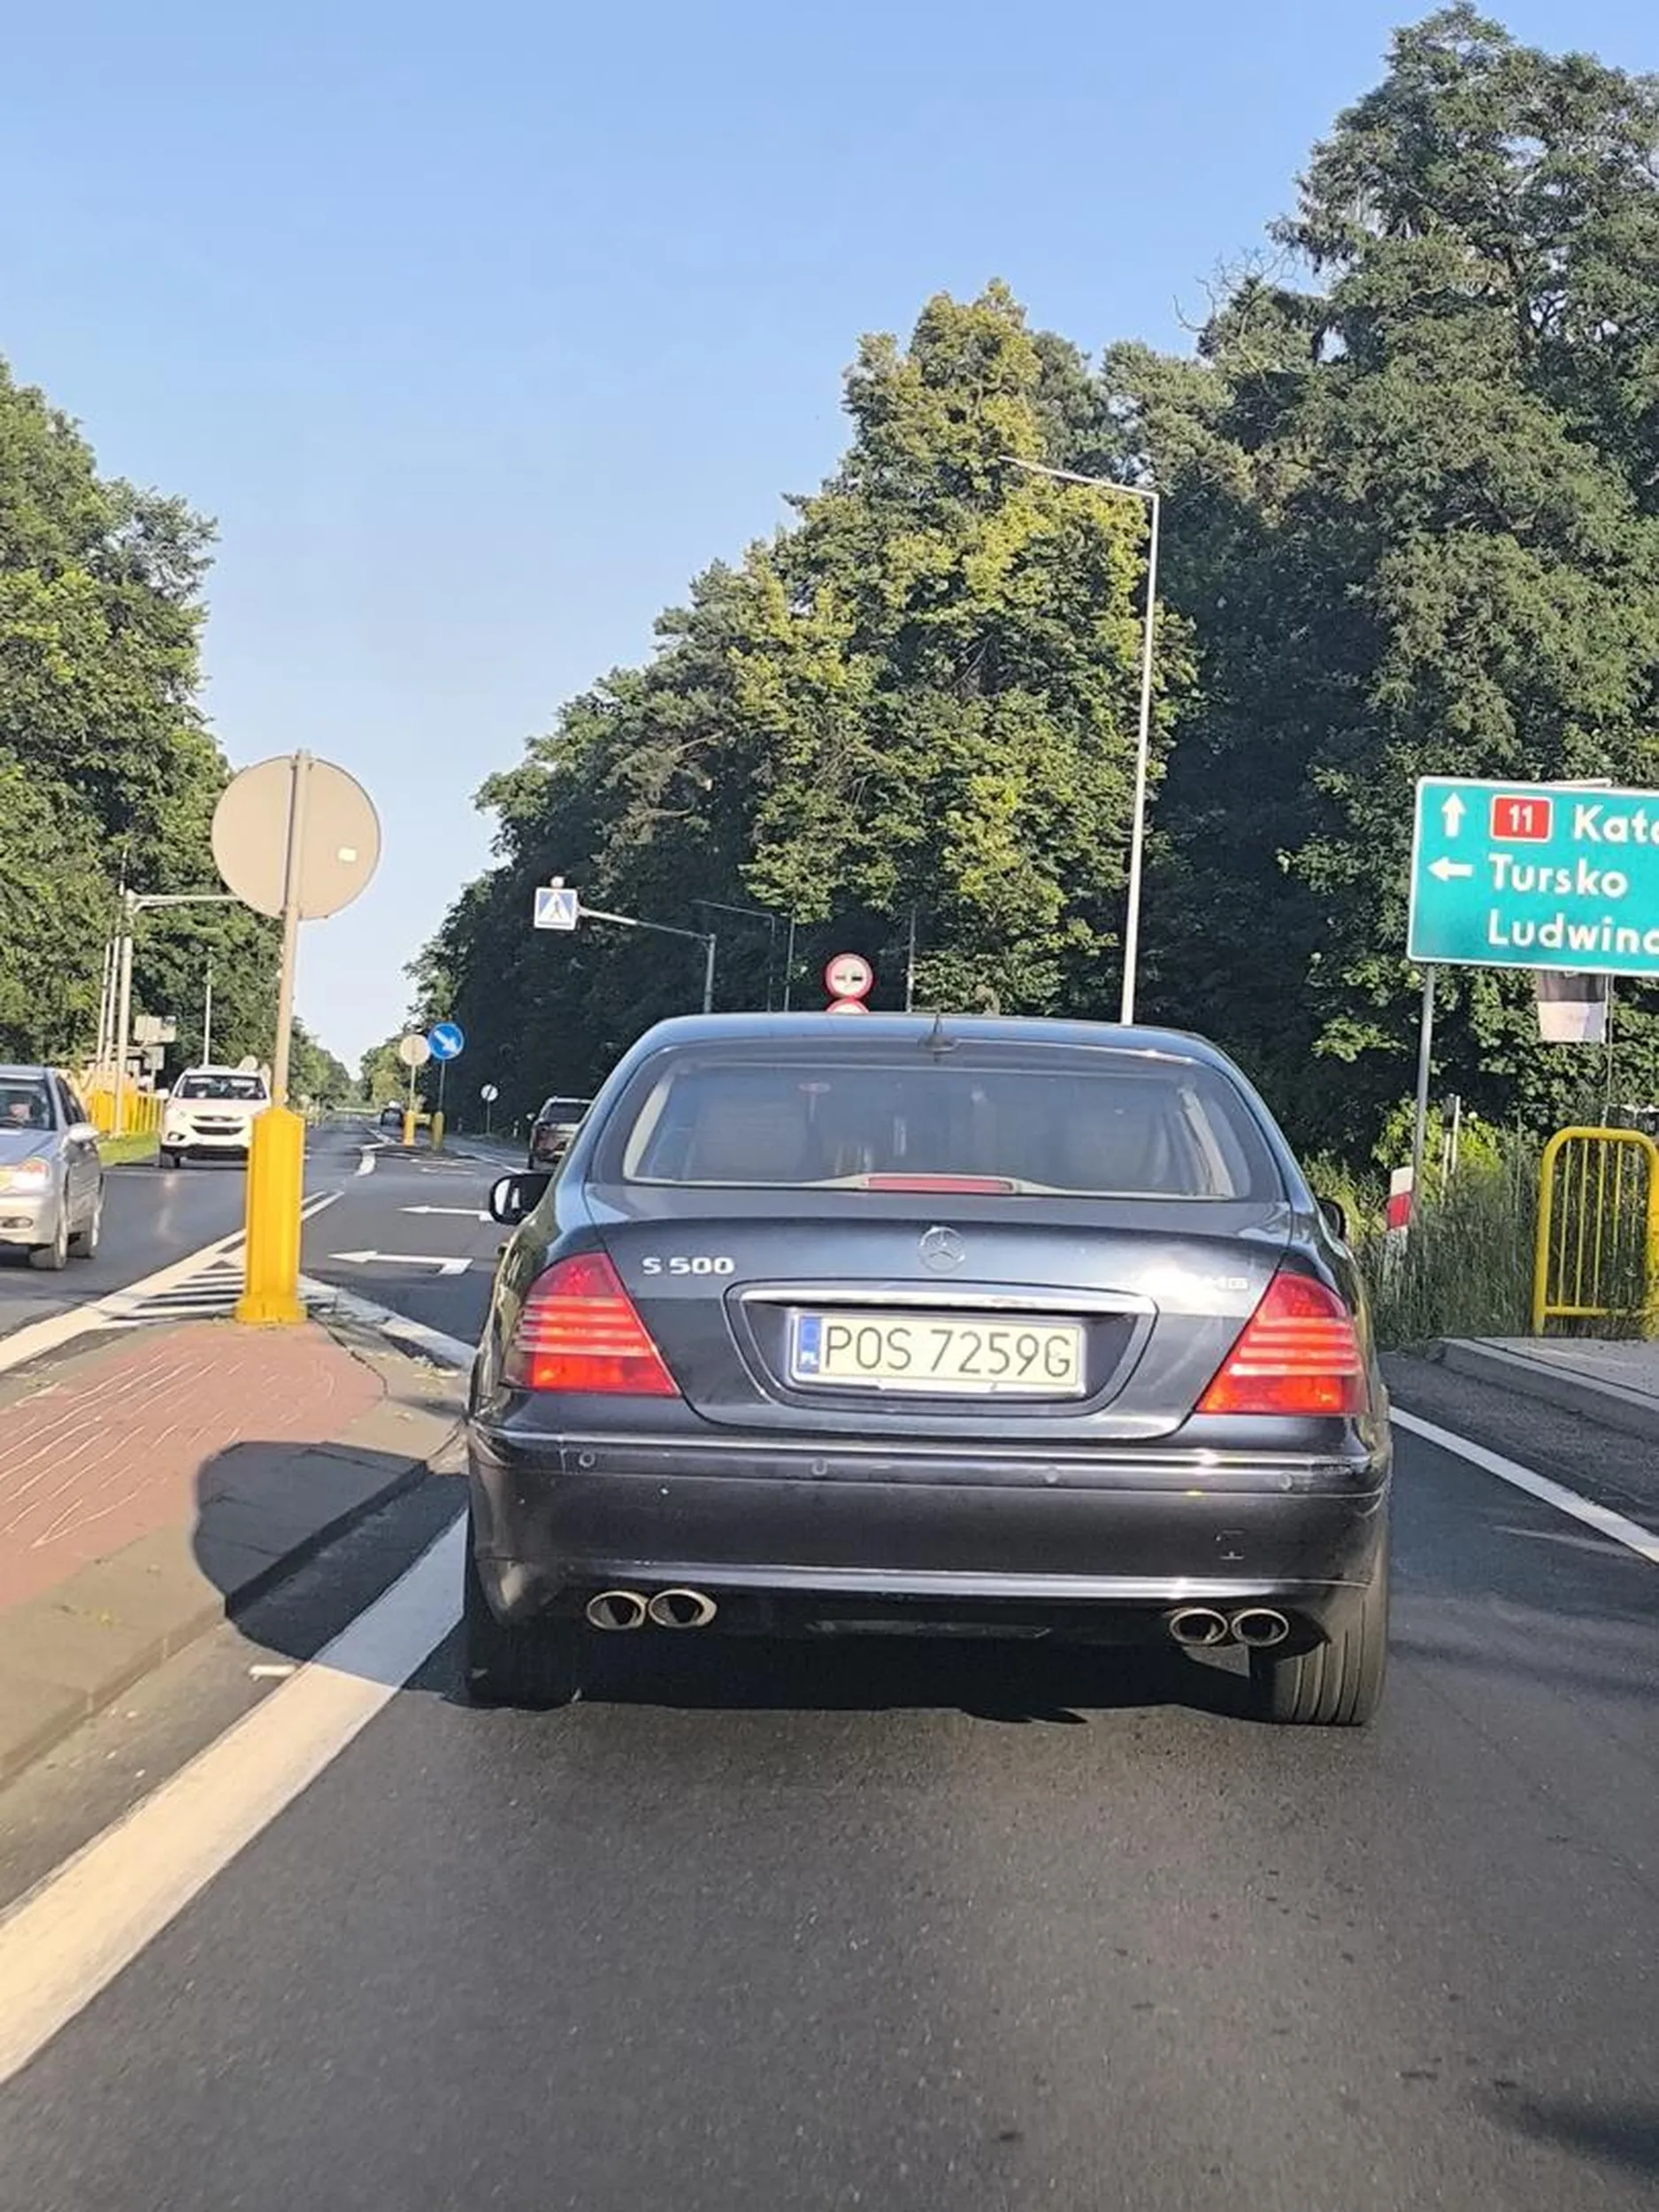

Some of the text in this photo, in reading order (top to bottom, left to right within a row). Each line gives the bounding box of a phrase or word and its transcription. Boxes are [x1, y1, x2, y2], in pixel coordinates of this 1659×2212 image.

[1508, 805, 1533, 833] 11
[1488, 853, 1628, 898] Tursko
[642, 1257, 734, 1275] S 500
[826, 1325, 1071, 1378] POS 7259G
